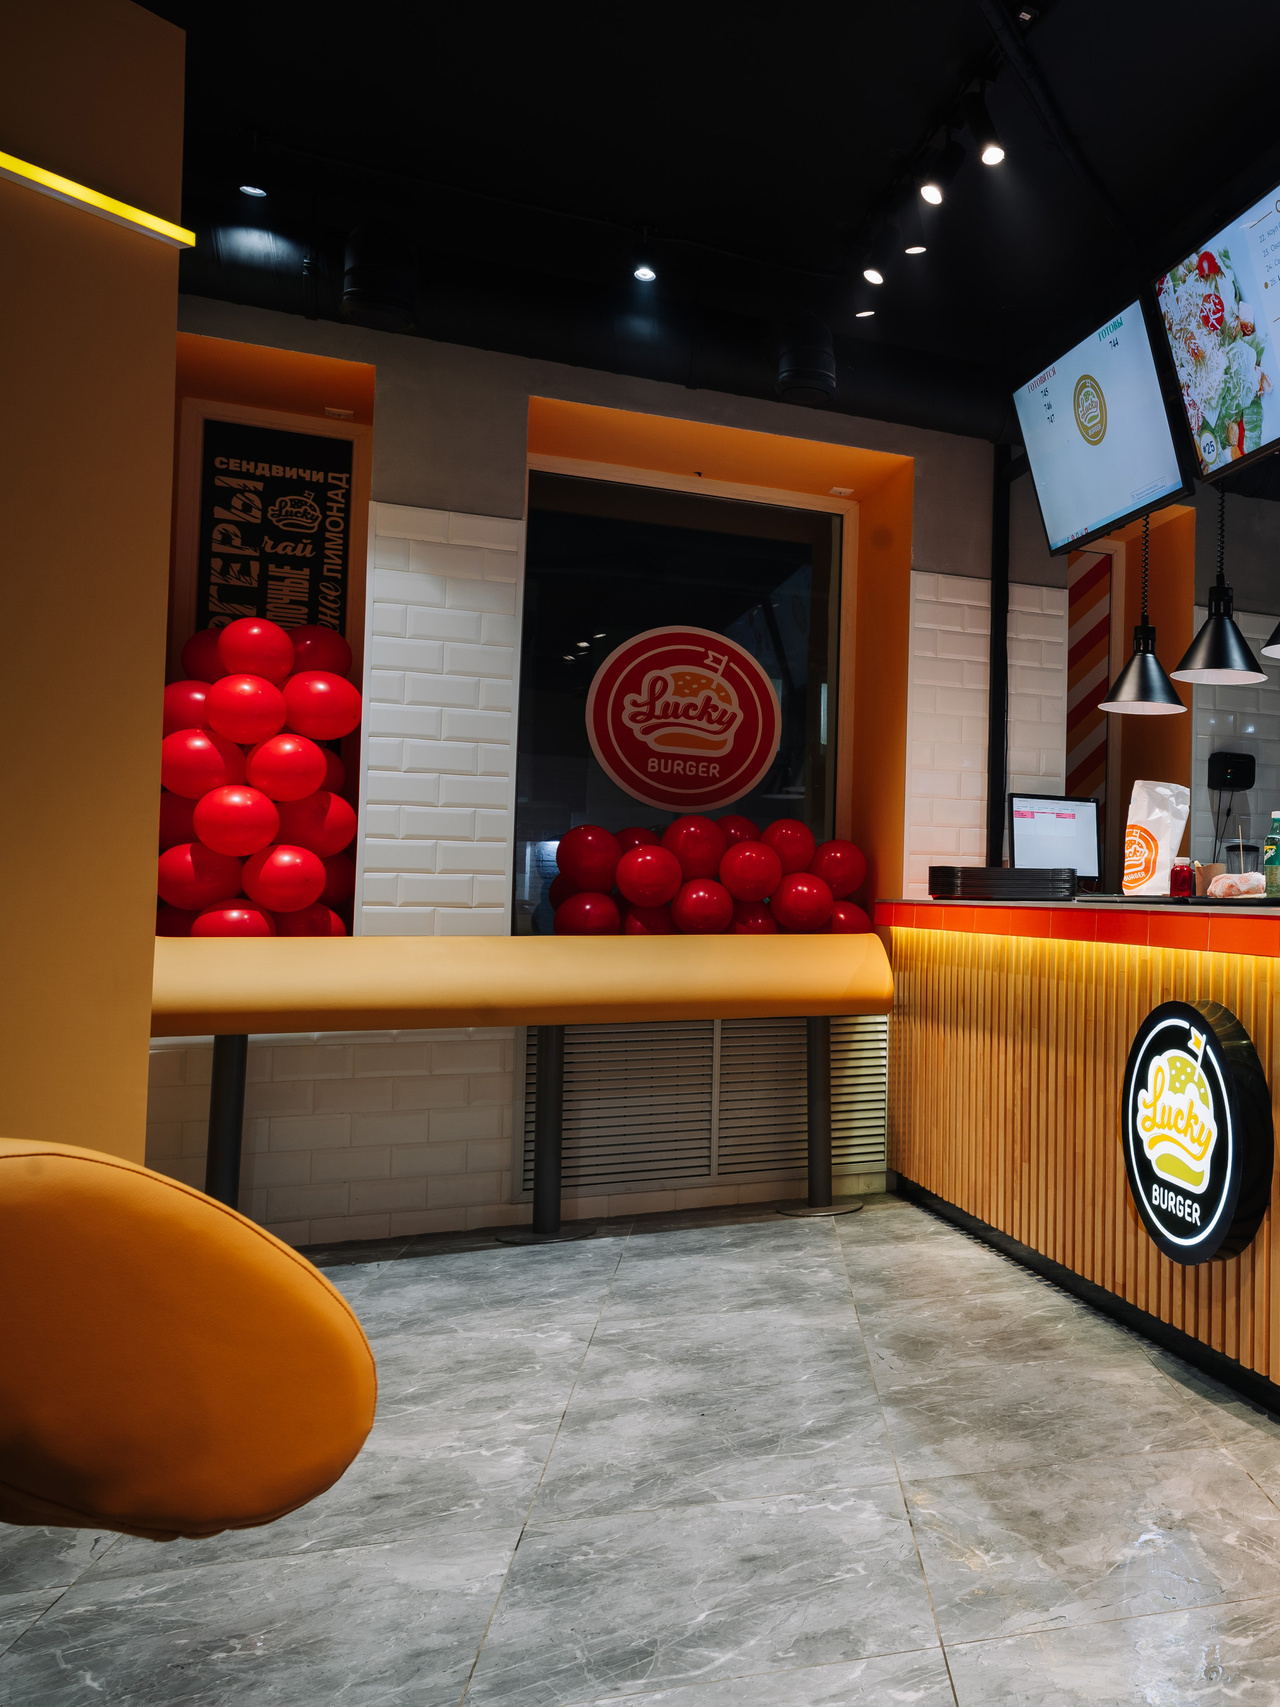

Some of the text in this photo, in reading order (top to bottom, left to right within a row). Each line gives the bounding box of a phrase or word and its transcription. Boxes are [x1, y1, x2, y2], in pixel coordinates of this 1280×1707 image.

[1098, 317, 1124, 342] ГОТОВЫ
[1027, 366, 1056, 393] ГОТОВЯТСЯ
[215, 456, 324, 483] СЕНДВИЧИ
[271, 498, 320, 521] Lucky
[323, 472, 350, 579] ЛИМОНАД
[628, 676, 737, 735] Lucky
[648, 758, 720, 777] BURGER
[1124, 871, 1146, 881] BURGER
[1142, 1065, 1212, 1161] Lucky
[1152, 1184, 1200, 1226] BURGER
